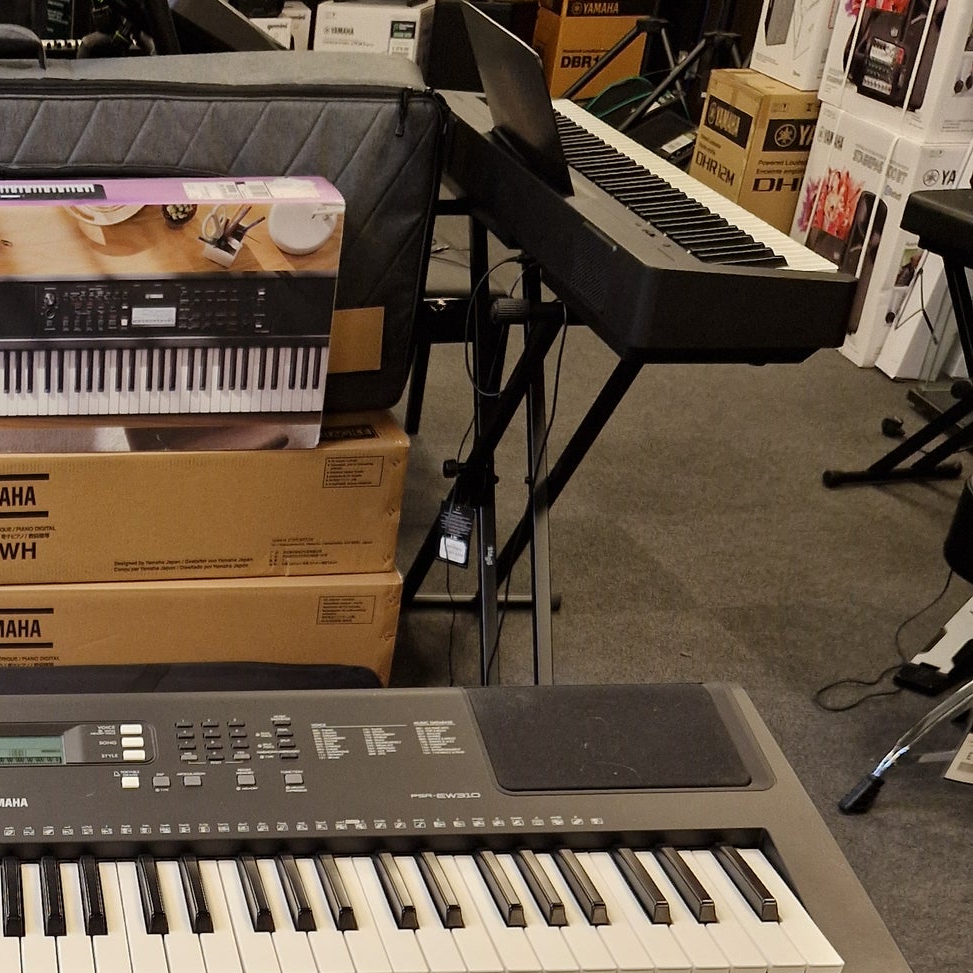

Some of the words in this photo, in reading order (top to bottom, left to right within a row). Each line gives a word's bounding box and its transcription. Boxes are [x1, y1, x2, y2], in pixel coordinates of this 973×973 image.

[583, 2, 619, 14] YAMAHA
[331, 27, 354, 35] YAMAHA
[561, 55, 600, 69] DBR1
[752, 177, 804, 192] DH
